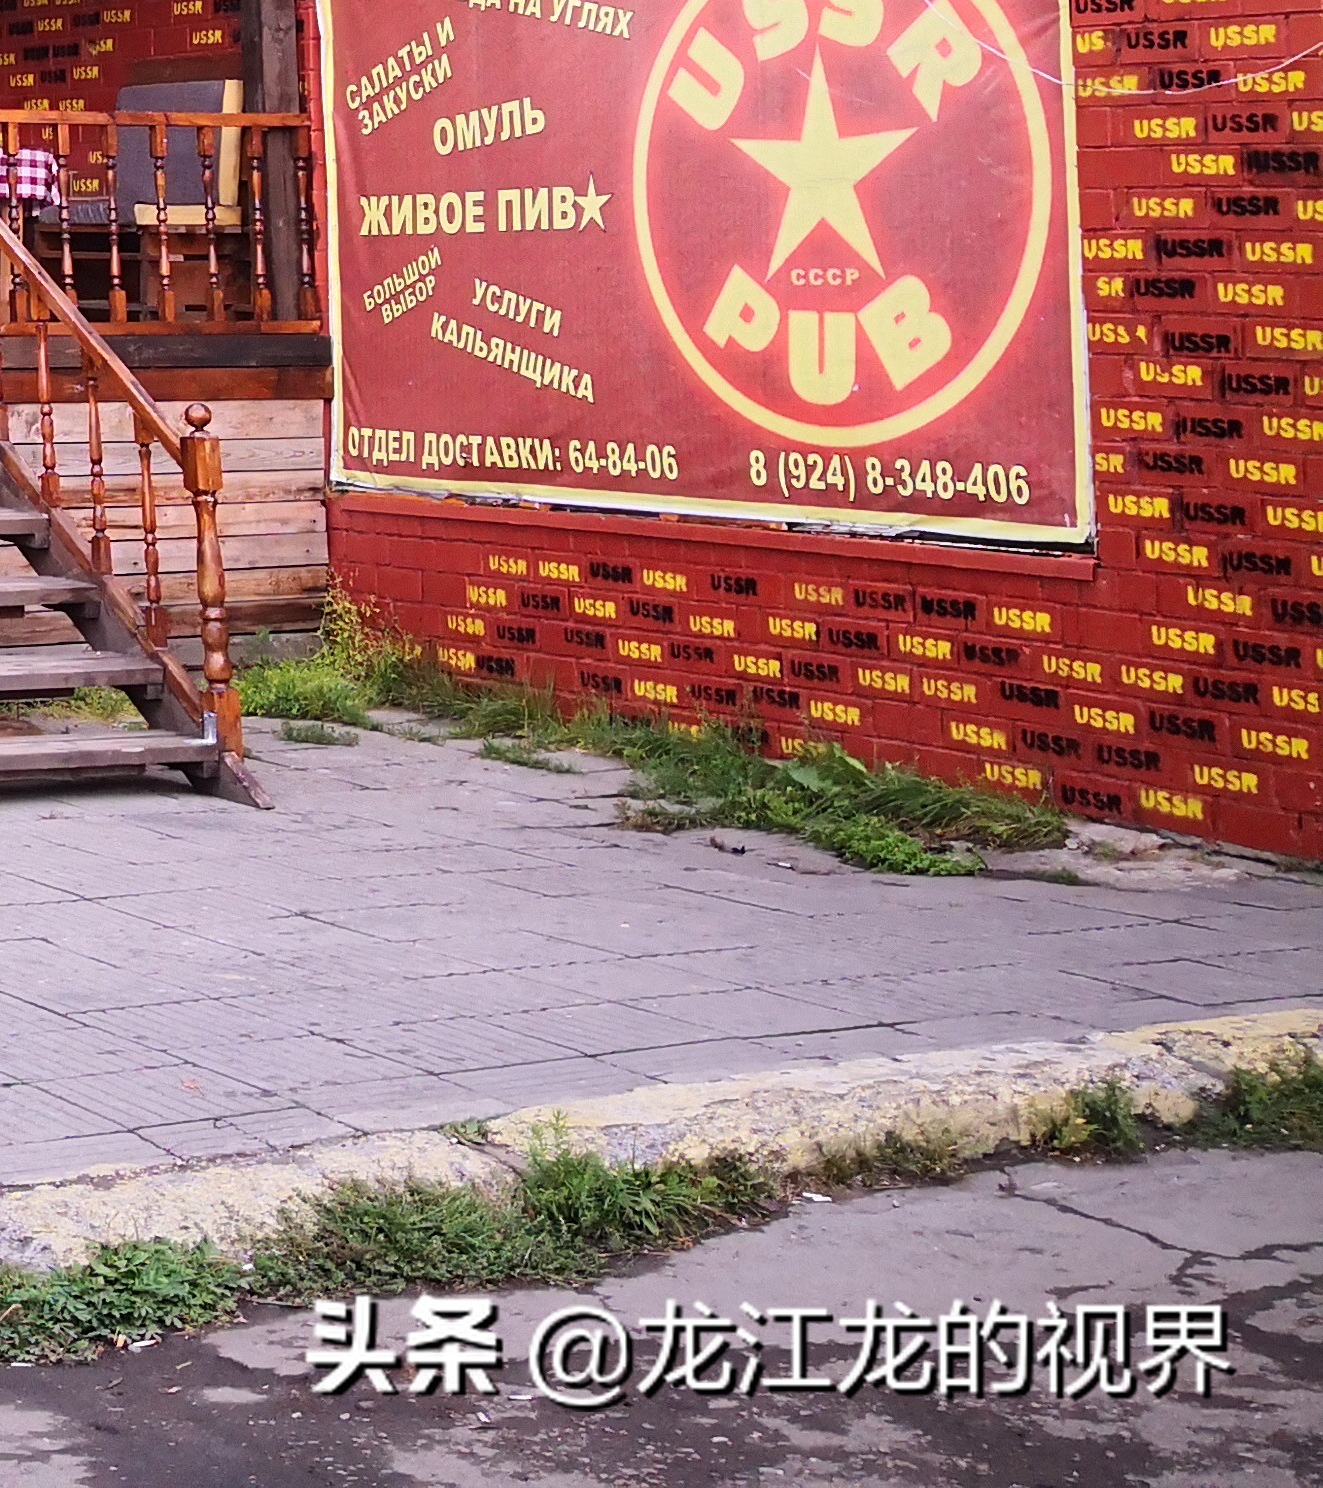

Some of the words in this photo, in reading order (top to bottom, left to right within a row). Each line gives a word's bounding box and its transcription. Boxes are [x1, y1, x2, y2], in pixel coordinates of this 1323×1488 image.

[104, 11, 131, 23] USSR
[174, 1, 203, 15] USSR
[37, 19, 63, 32] USSR
[192, 30, 222, 45] USSR
[1210, 25, 1276, 49] USSR
[1126, 30, 1189, 50] USSR
[73, 67, 100, 79] USSR
[345, 32, 433, 110] САЛАТЫ
[436, 16, 455, 48] И
[10, 74, 34, 87] USSR
[1077, 75, 1138, 97] USSR
[1238, 71, 1306, 93] USSR
[357, 53, 452, 136] ЗАКУСКИ
[433, 97, 545, 156] ОМУЛЬ
[1134, 117, 1196, 138] USSR
[1171, 154, 1235, 175] USSR
[73, 179, 100, 192] USSR
[359, 190, 485, 236] ЖИВОЕ
[1133, 198, 1194, 218] USSR
[1084, 239, 1144, 259] USSR
[1245, 242, 1313, 264] USSR
[363, 244, 442, 312] БОЛЬШОЙ
[381, 275, 437, 325] ВЫБОР
[1217, 283, 1284, 305] USSR
[472, 278, 562, 338] УСЛУГИ
[703, 264, 952, 405] PUB
[430, 312, 595, 404] КАЛЬЯНЩИКА
[1101, 408, 1162, 432] USSR
[348, 426, 415, 467] ОТДЕЛ
[422, 432, 561, 472] ДОСТАВКИ:
[568, 439, 679, 482] 64-84-06
[749, 449, 768, 488] 8
[778, 451, 856, 502] (924)
[866, 455, 1031, 507] 8-348-406
[1230, 460, 1296, 484] USSR
[1108, 496, 1170, 518] USSR
[1145, 542, 1208, 567] USSR
[539, 562, 579, 581] USSR
[643, 571, 686, 591] USSR
[795, 584, 842, 605] USSR
[1188, 587, 1252, 616] USSR
[574, 599, 616, 618] USSR
[994, 608, 1051, 632] USSR
[690, 617, 734, 636] USSR
[769, 618, 816, 640] USSR
[619, 641, 661, 661] USSR
[898, 635, 951, 660] USSR
[1152, 626, 1215, 654] USSR
[734, 656, 781, 677] USSR
[1043, 656, 1101, 683] USSR
[859, 670, 909, 693] USSR
[923, 679, 976, 702] USSR
[1122, 667, 1183, 693] USSR
[634, 682, 677, 703] USSR
[999, 683, 1061, 709] USSR
[810, 701, 860, 725] USSR
[1074, 706, 1134, 733] USSR
[951, 723, 1006, 749] USSR
[1241, 729, 1308, 759] USSR
[1095, 744, 1162, 771] USSR
[984, 764, 1042, 788] USSR
[1195, 766, 1258, 793] USSR
[1141, 791, 1203, 820] USSR
